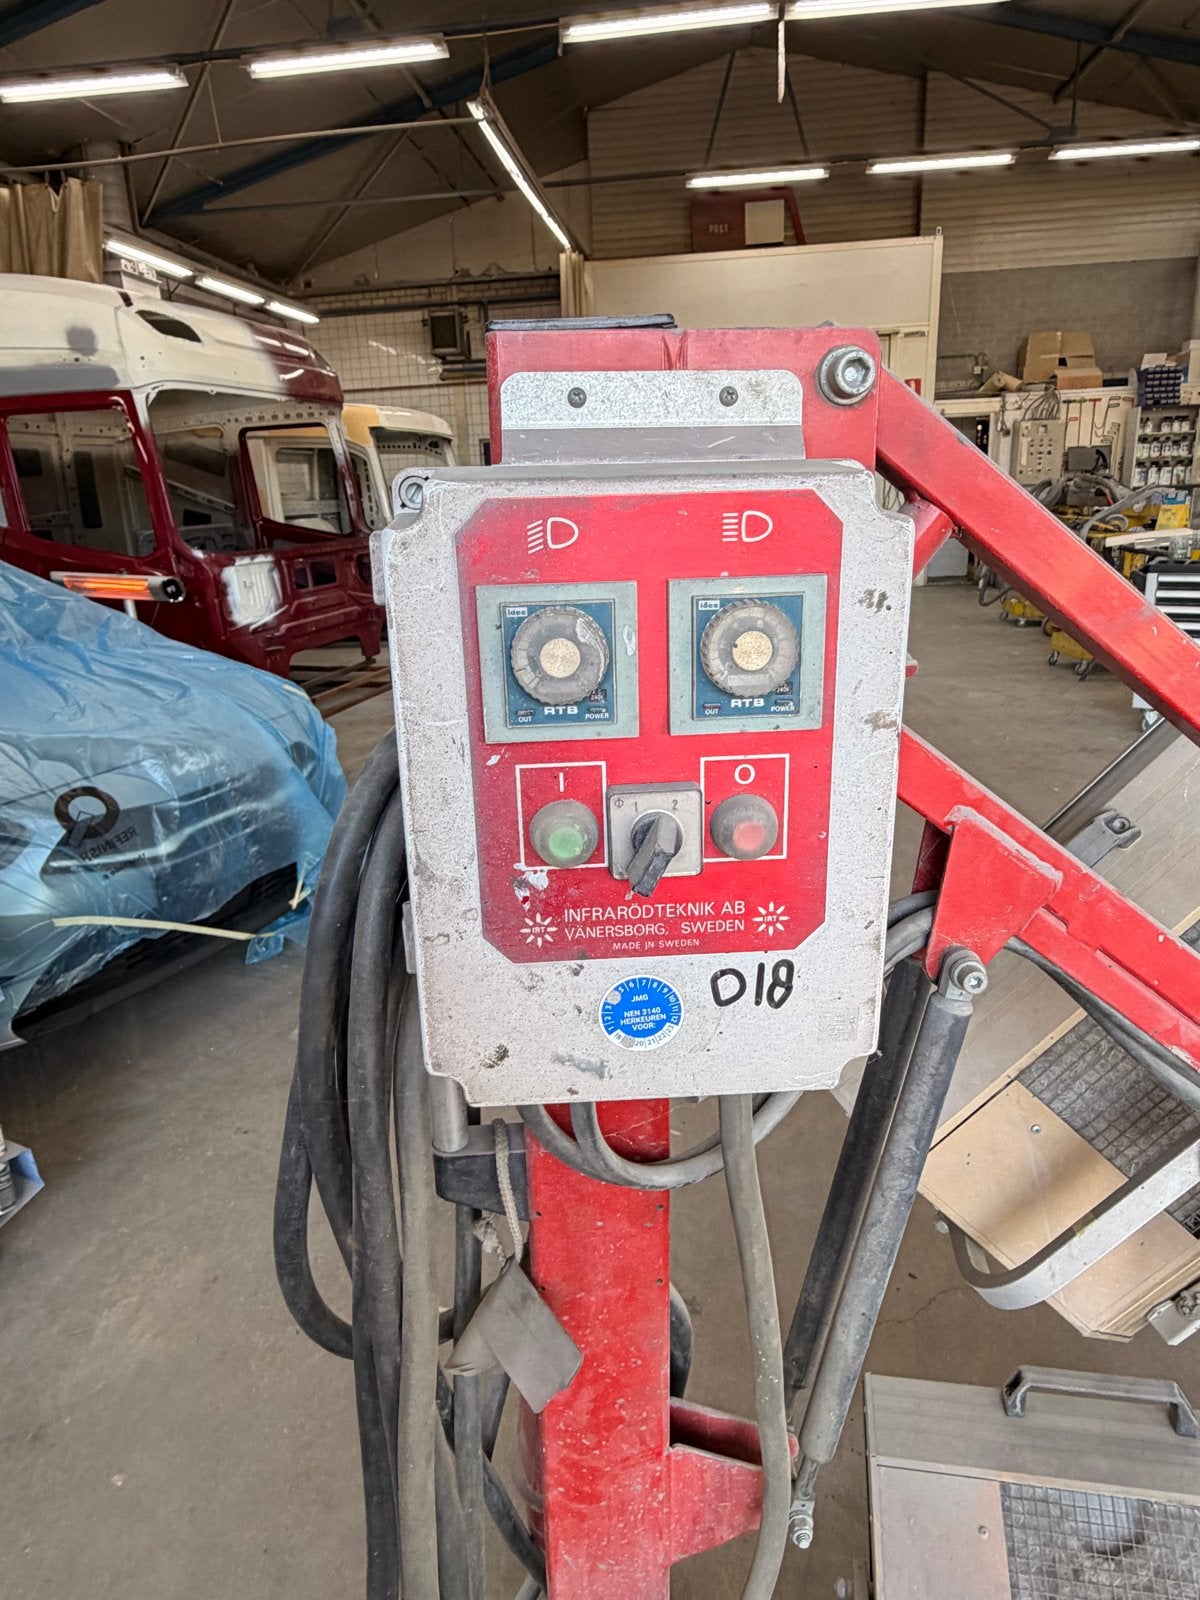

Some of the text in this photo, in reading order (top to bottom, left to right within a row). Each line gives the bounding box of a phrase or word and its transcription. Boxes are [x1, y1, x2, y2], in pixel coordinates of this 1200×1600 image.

[709, 223, 729, 234] POST
[731, 698, 765, 708] RTB
[544, 706, 578, 715] RTB
[585, 712, 609, 720] POWER
[672, 799, 679, 811] 2
[564, 900, 745, 922] INFRARÖDTEKNIK AB
[565, 919, 745, 940] VÄNERSBORG, SWEDEN
[613, 938, 700, 951] MADE IN SWEDEN
[631, 993, 649, 1002] JMG
[668, 995, 676, 1003] 10
[623, 1006, 662, 1018] NEN 3140
[620, 1013, 667, 1026] HERKEUREN
[631, 1022, 657, 1031] VOOR:
[657, 1033, 667, 1041] 22
[666, 1024, 675, 1033] 23
